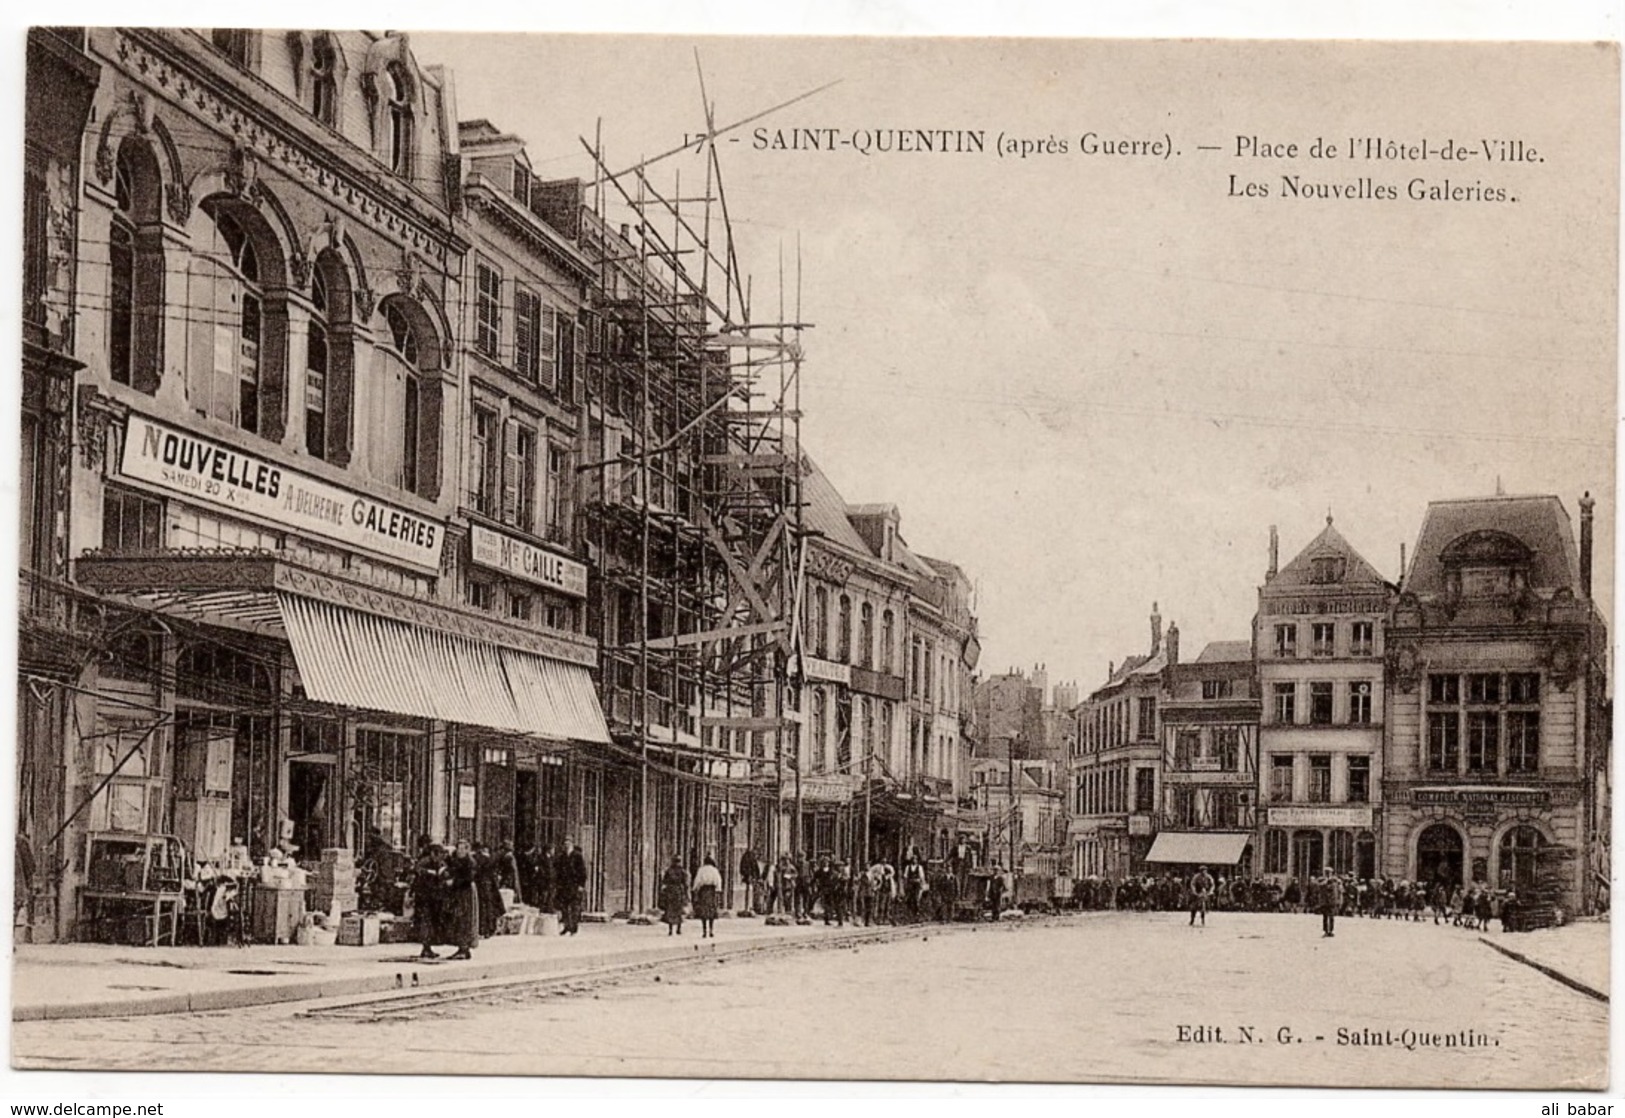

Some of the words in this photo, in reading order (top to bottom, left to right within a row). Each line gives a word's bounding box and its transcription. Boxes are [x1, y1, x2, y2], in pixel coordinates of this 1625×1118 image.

[142, 424, 281, 498] NOUVELLES
[351, 498, 436, 549] GALERIES
[161, 467, 202, 492] SAMEDI
[204, 480, 221, 496] 20
[523, 546, 564, 586] CAILLE
